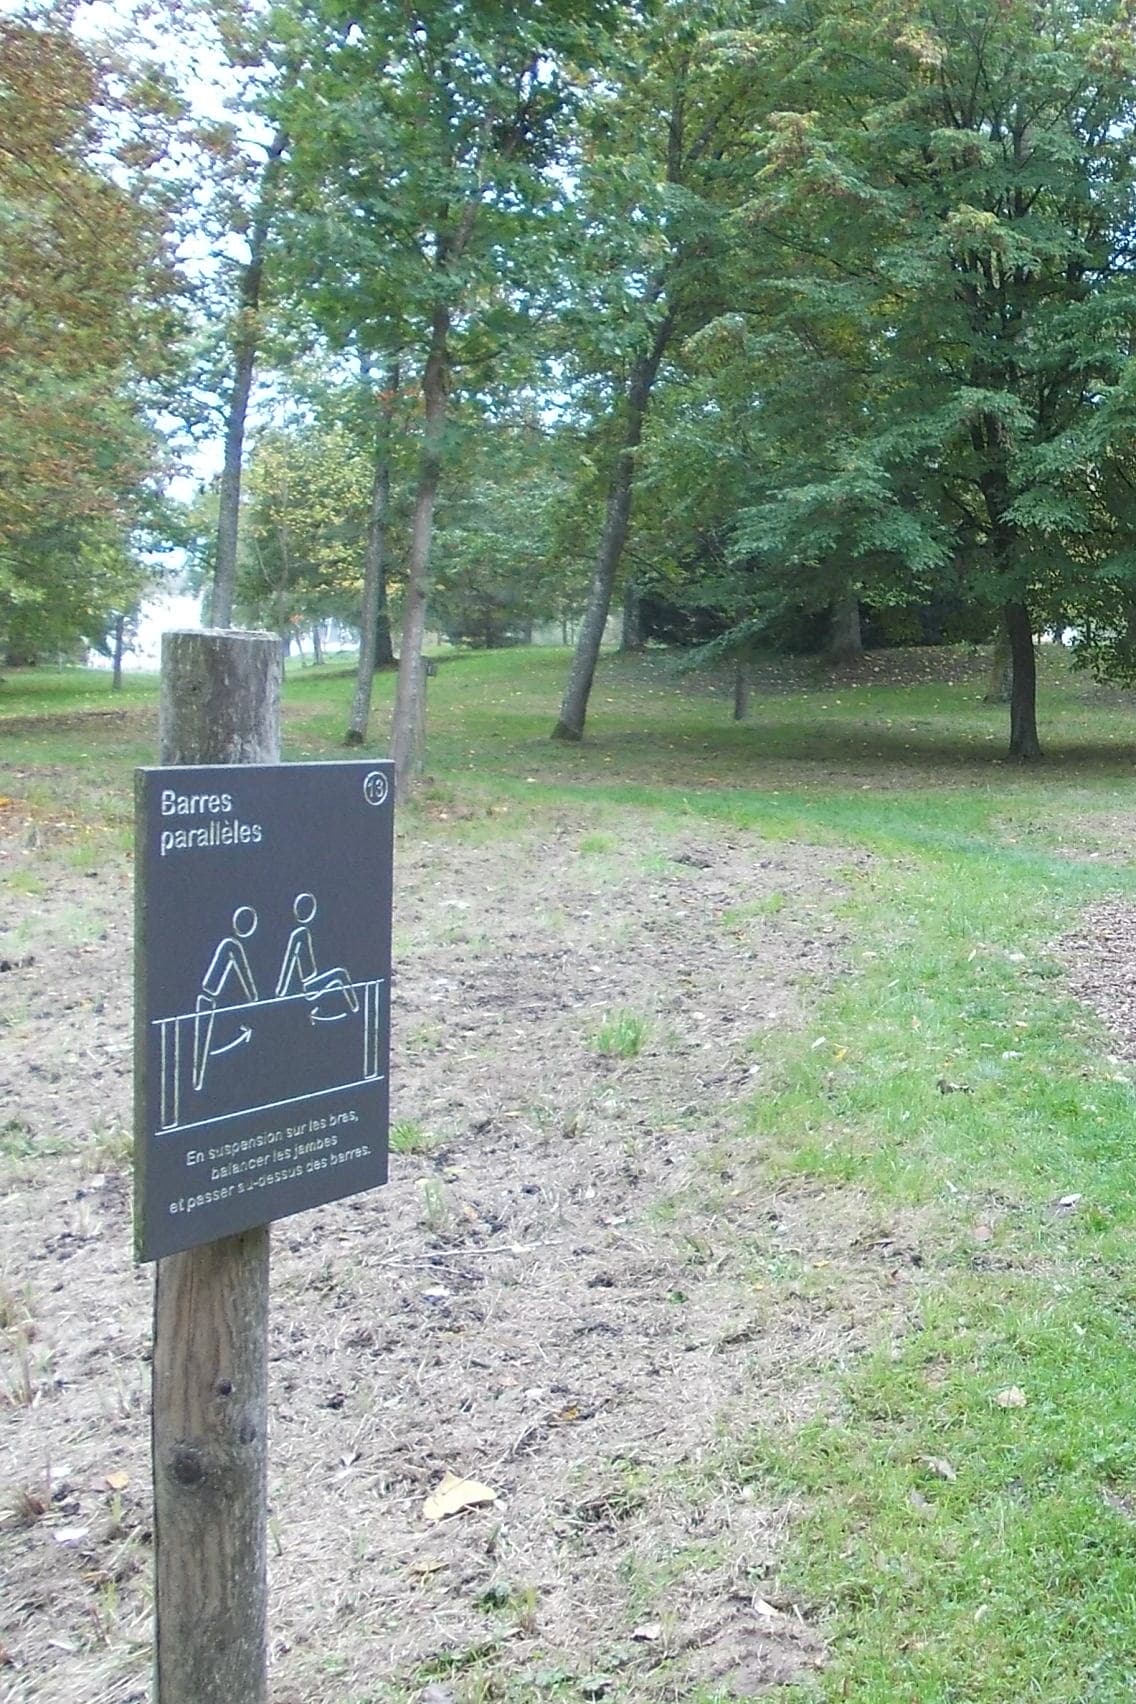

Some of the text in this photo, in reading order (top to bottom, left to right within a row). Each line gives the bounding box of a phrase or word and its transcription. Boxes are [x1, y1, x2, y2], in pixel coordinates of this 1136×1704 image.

[161, 790, 233, 816] Barres
[367, 779, 384, 798] 13
[160, 819, 263, 856] parallèles
[186, 1150, 205, 1167] En
[208, 1130, 283, 1160] suspension
[286, 1123, 307, 1138] sur
[309, 1118, 327, 1133] les
[211, 1154, 270, 1181] balancer
[273, 1147, 292, 1163] les
[169, 1198, 186, 1215] et
[187, 1185, 235, 1213] passer
[306, 1155, 328, 1174] des
